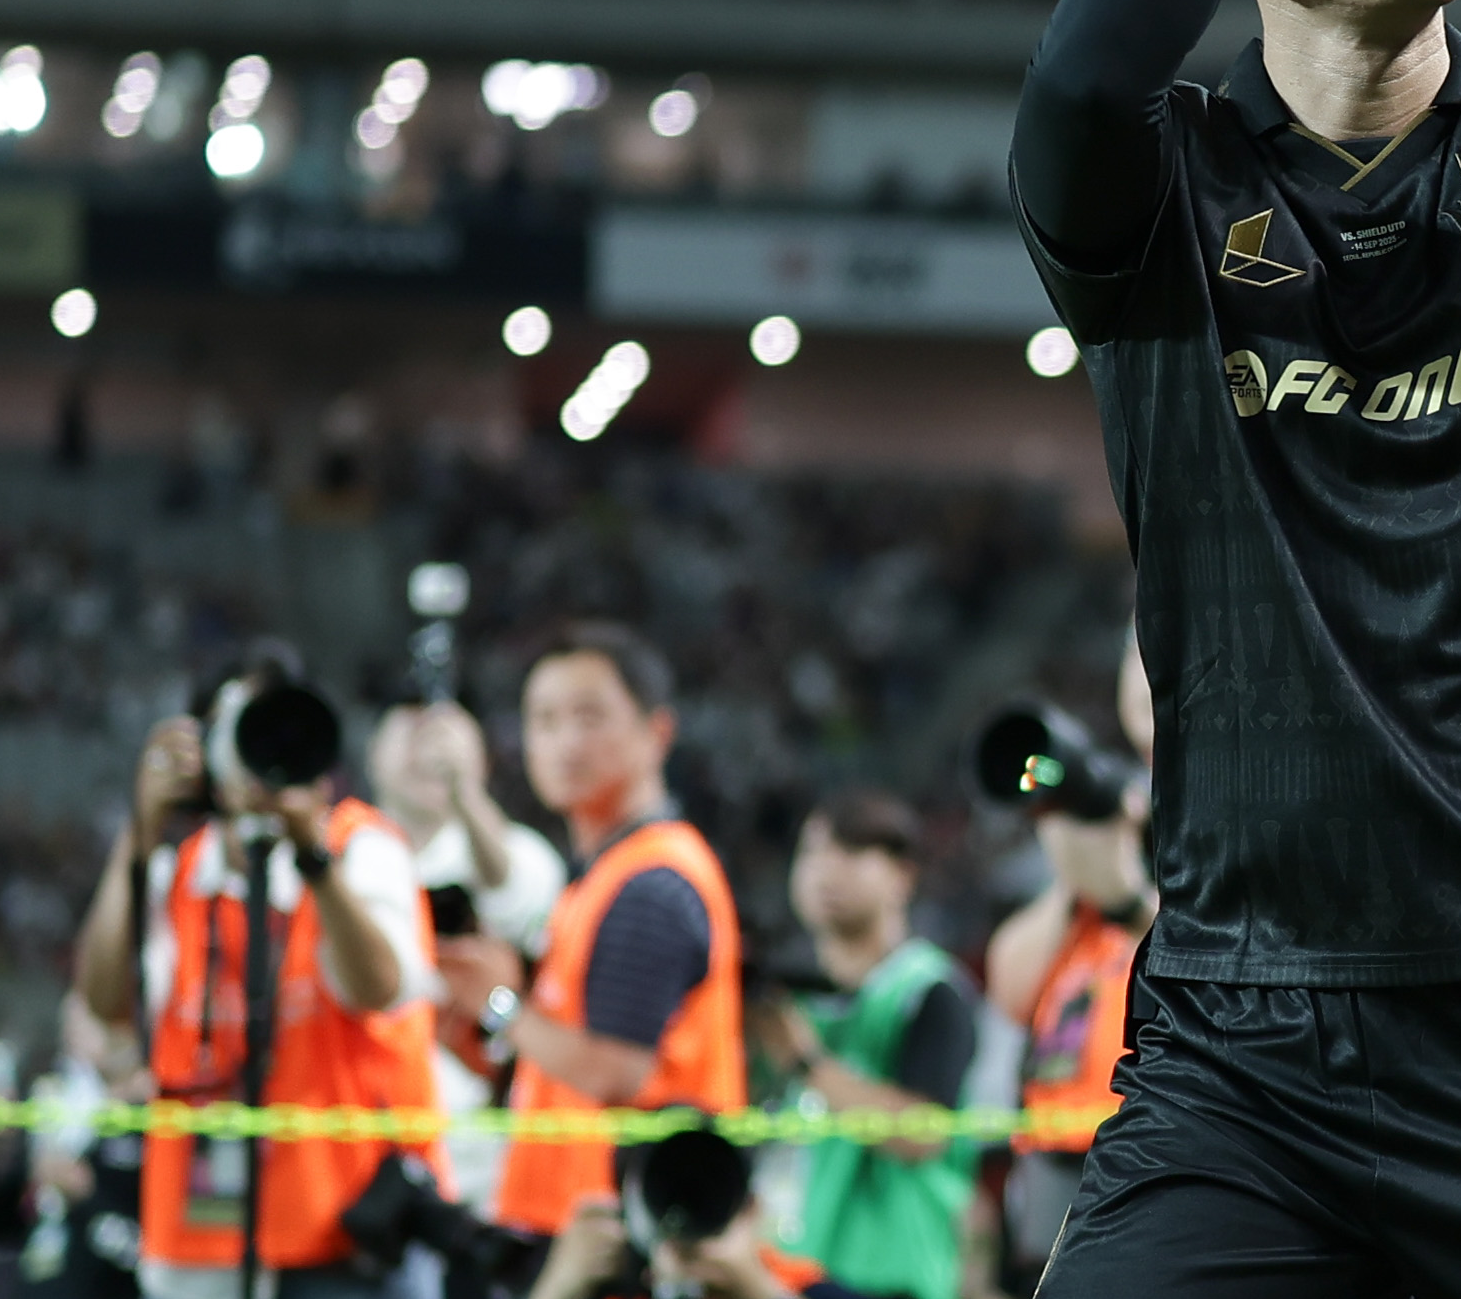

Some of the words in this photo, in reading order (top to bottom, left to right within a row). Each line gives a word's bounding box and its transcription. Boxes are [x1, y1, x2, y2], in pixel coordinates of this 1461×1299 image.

[1340, 232, 1356, 241] VS.
[1356, 226, 1387, 239] SHIELD
[1387, 221, 1406, 232] UTD
[1363, 240, 1377, 250] SEP
[1227, 365, 1260, 387] EA
[1230, 387, 1262, 398] PORTS
[1267, 359, 1357, 414] FC
